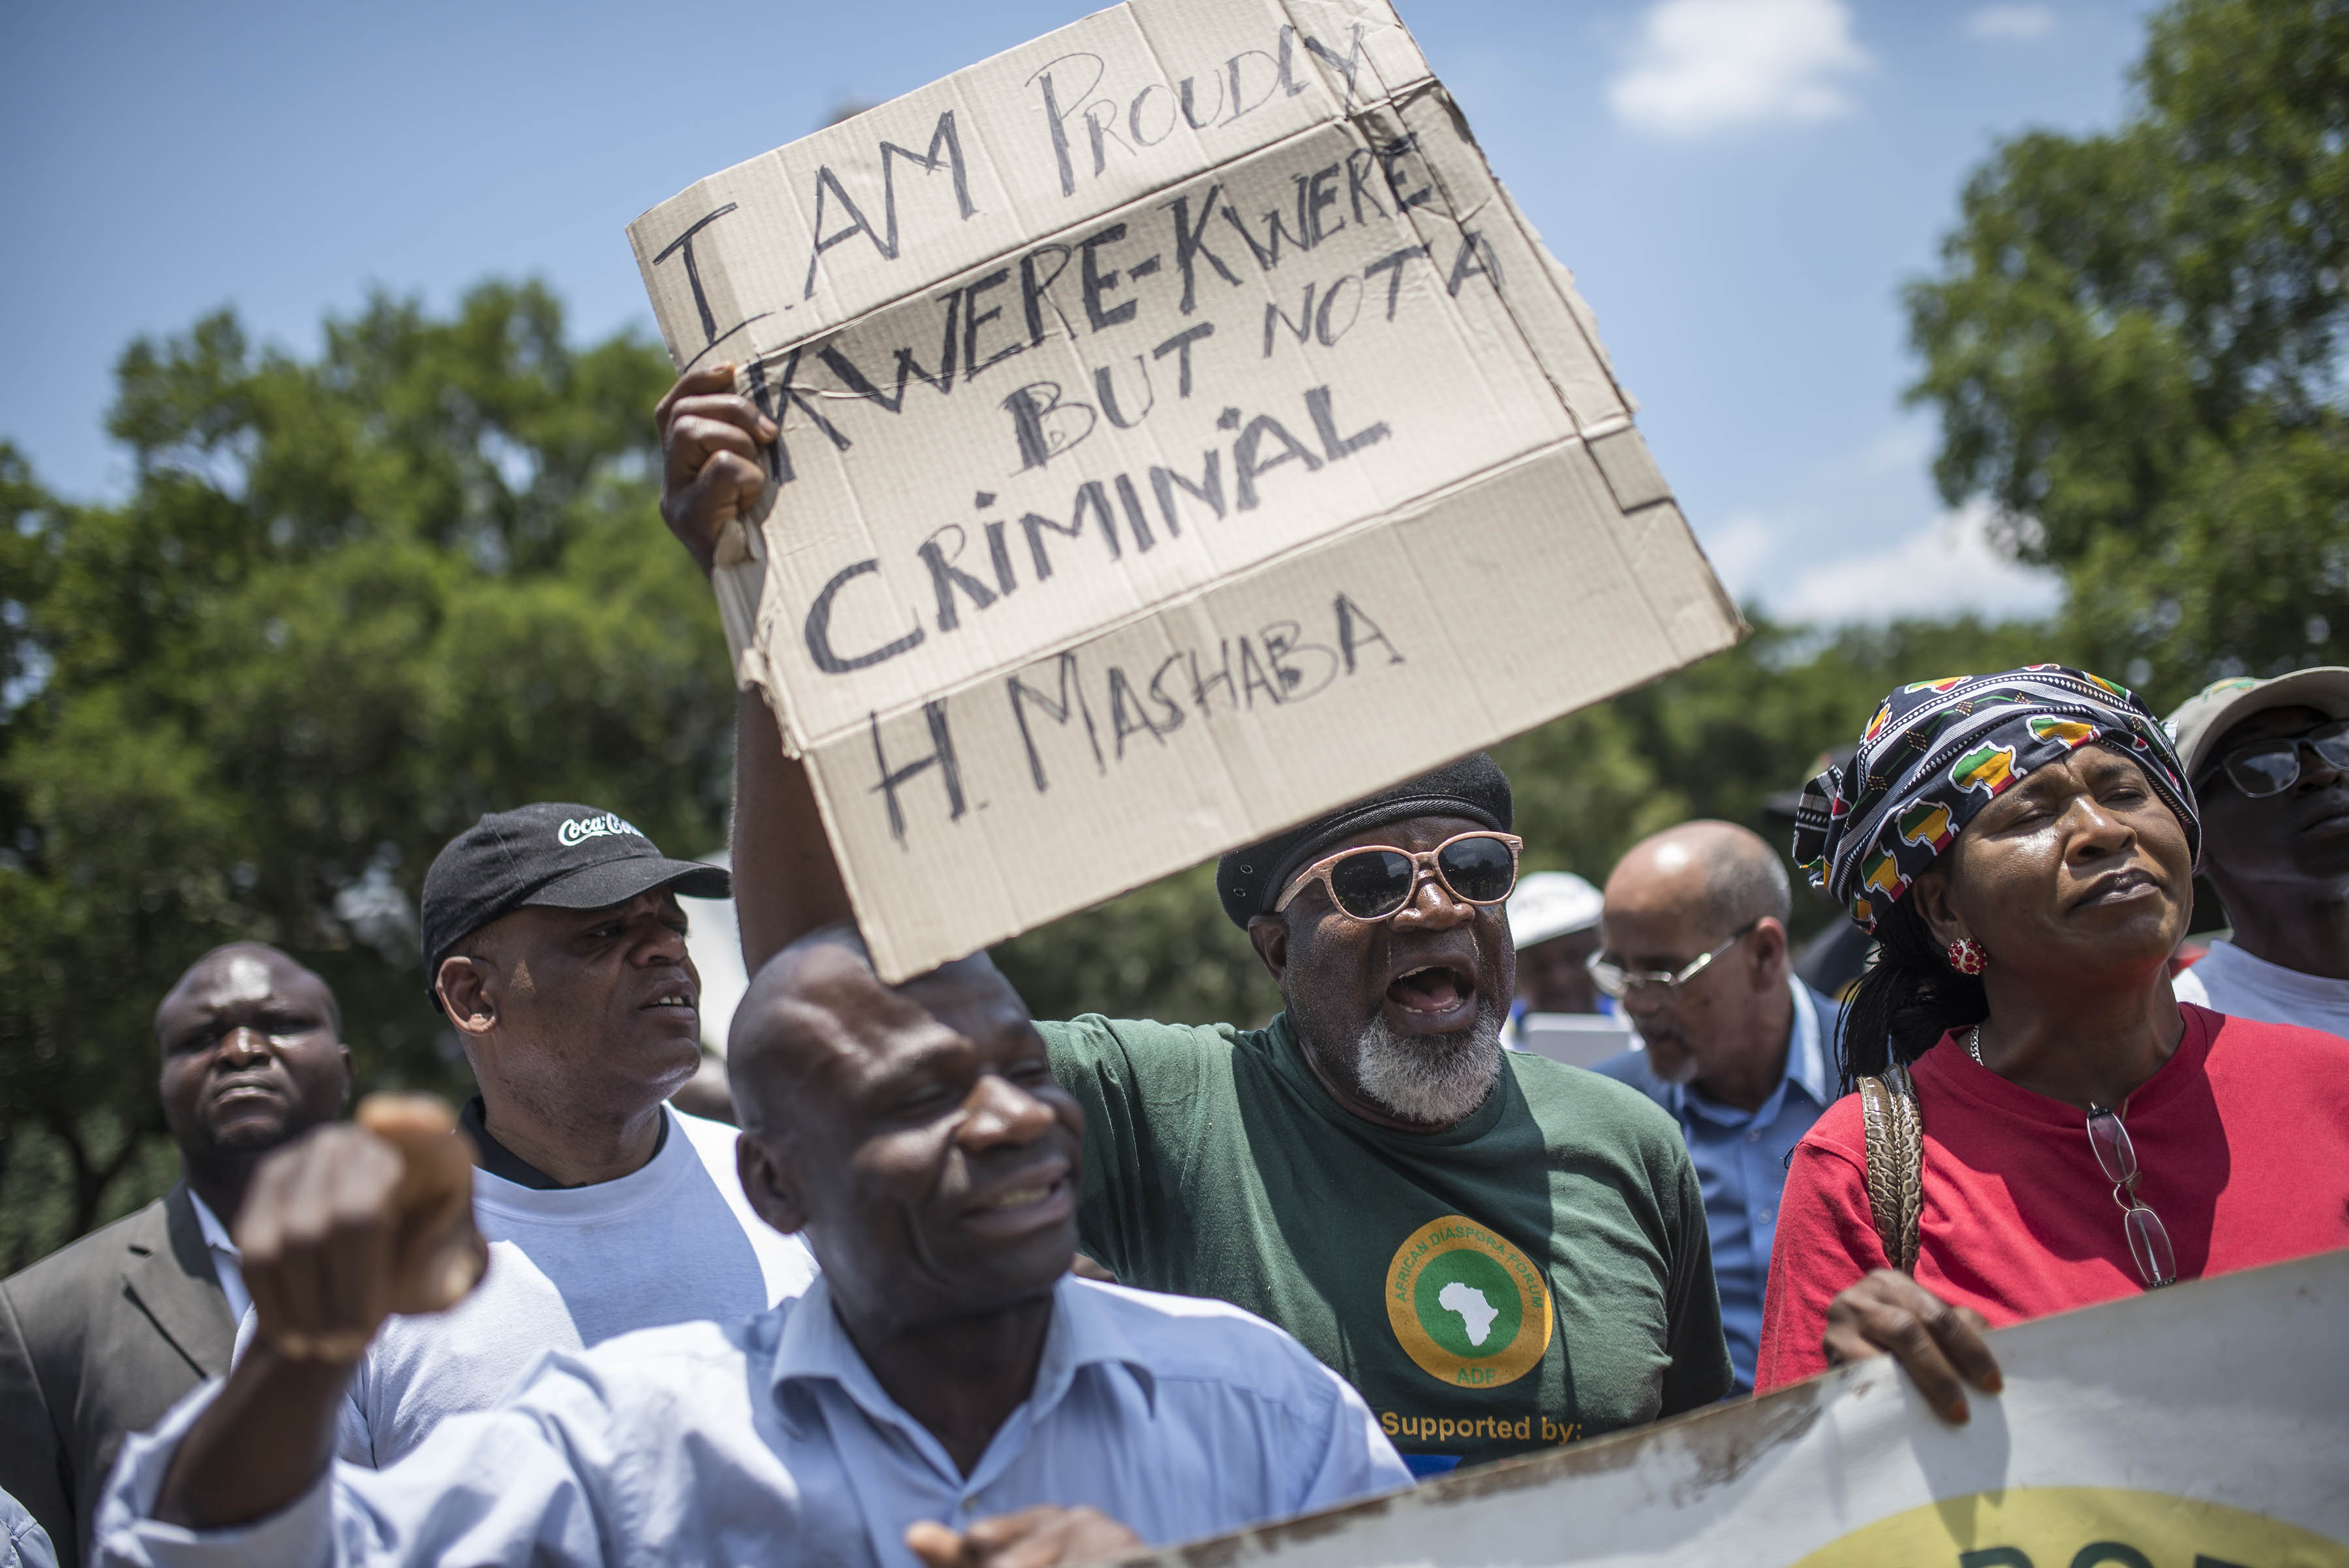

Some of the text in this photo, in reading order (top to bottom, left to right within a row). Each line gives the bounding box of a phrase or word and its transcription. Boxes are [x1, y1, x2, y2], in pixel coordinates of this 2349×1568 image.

[805, 110, 979, 300] AM
[1000, 322, 1214, 476] BUT
[1006, 591, 1405, 792] MASHABA
[558, 812, 645, 846] Coca-Co
[1395, 1226, 1543, 1308] AFRICAN DIASPORA FORUM
[1456, 1368, 1496, 1384] ADF
[1381, 1411, 1582, 1445] Supported by:
